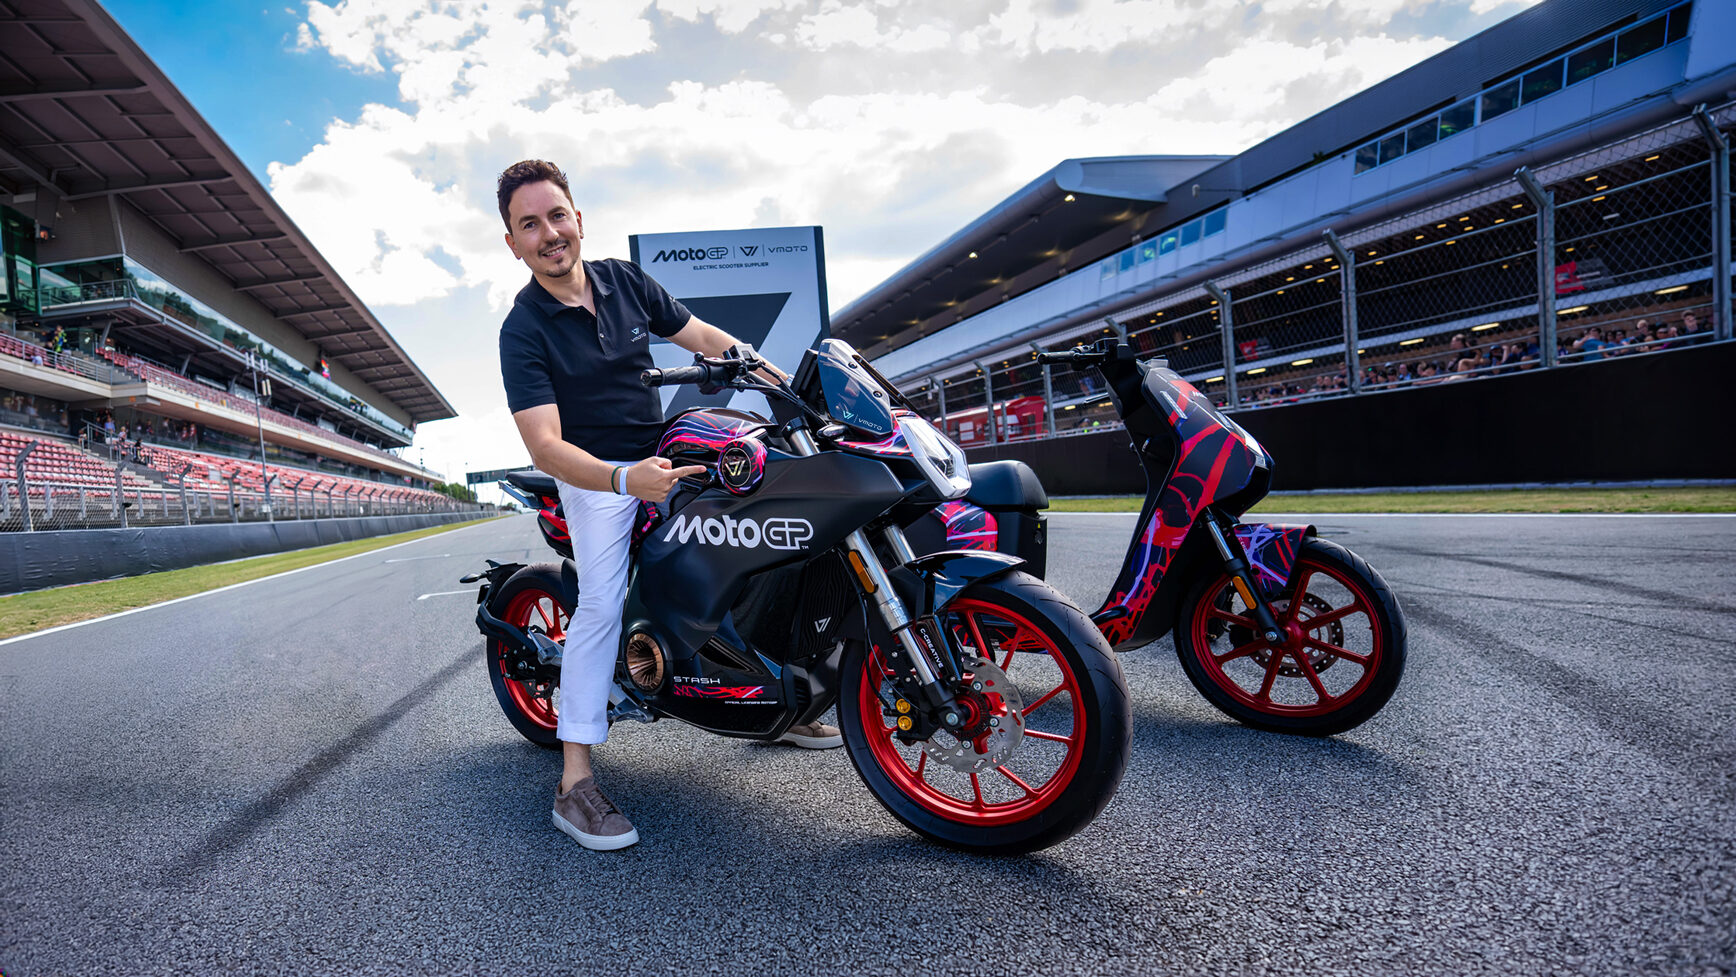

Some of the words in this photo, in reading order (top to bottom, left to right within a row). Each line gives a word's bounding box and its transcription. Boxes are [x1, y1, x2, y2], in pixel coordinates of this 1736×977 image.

[652, 246, 729, 263] MotoGP
[663, 514, 814, 550] MotoGP
[919, 627, 944, 669] C-CREATIVE
[673, 675, 721, 685] STASH
